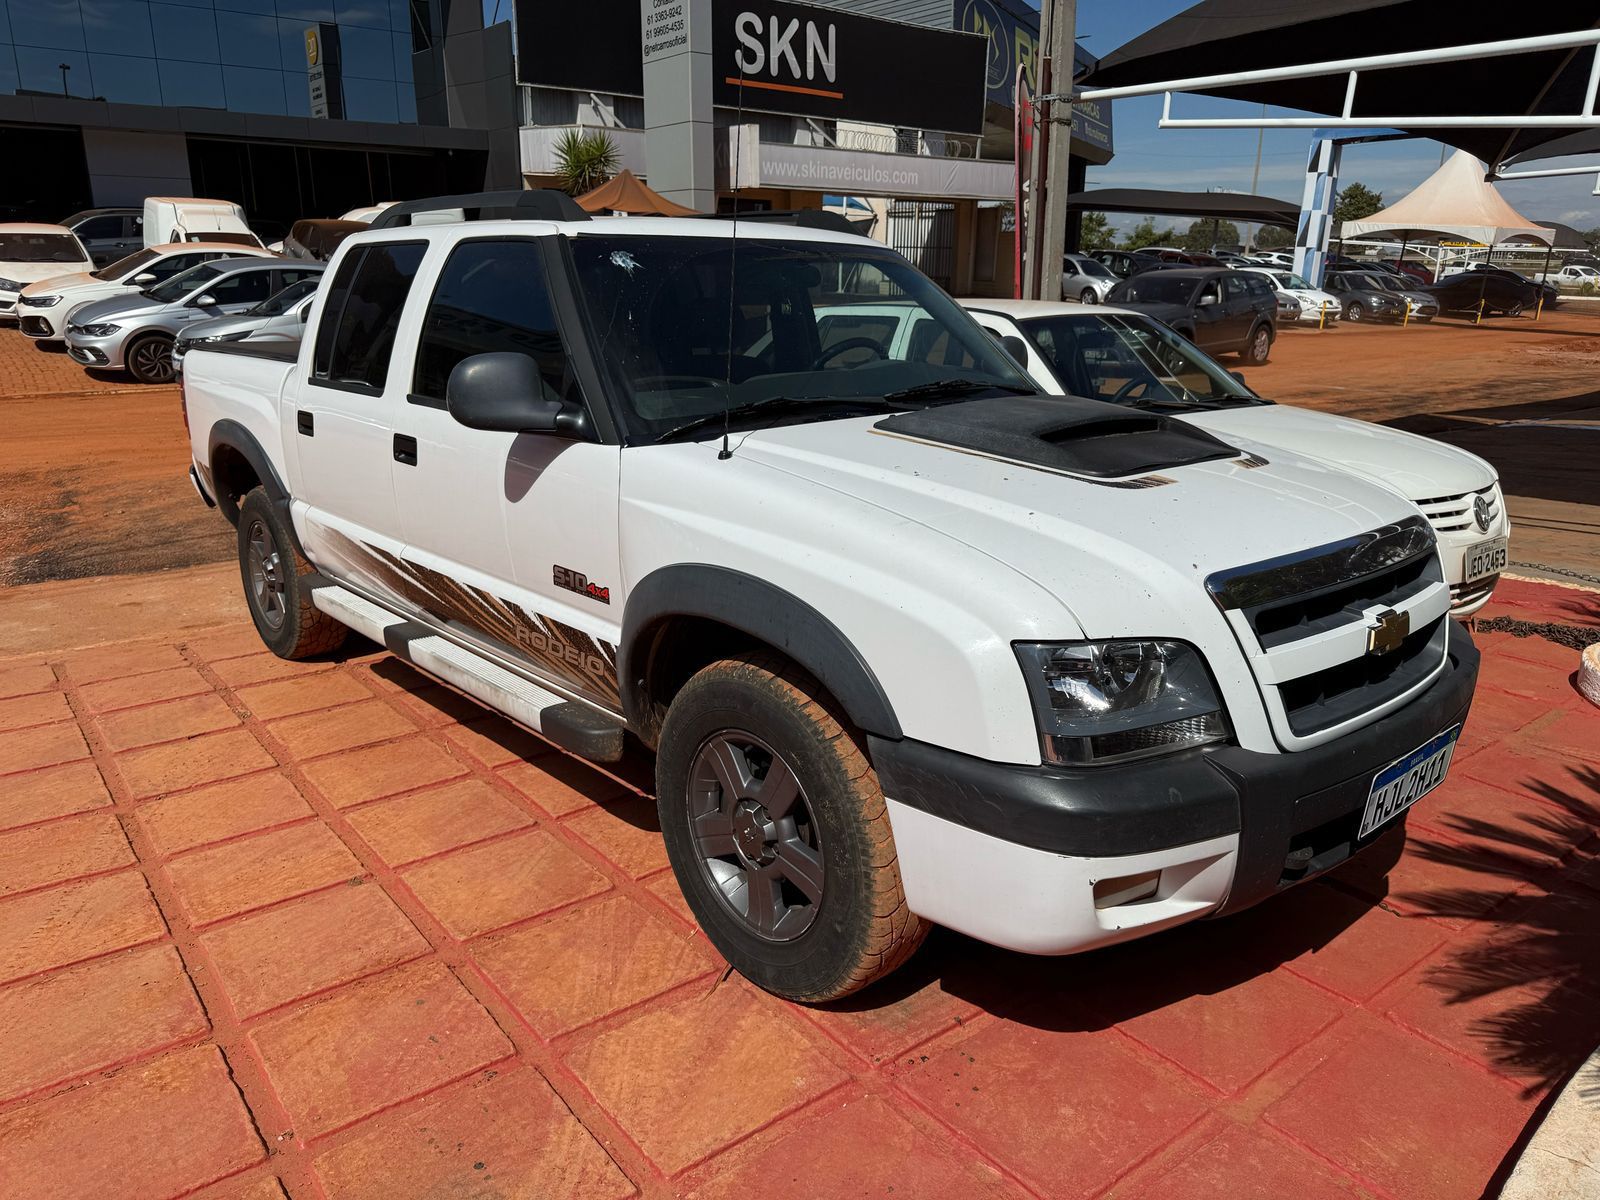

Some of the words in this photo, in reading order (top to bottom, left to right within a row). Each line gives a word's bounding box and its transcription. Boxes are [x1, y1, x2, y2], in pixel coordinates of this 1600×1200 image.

[647, 15, 654, 25] 61
[654, 5, 682, 22] 3363-9242
[646, 29, 652, 39] 61
[735, 12, 836, 83] SKN
[762, 160, 919, 185] www.skinaveiculos.com
[587, 583, 610, 600] 4x4
[516, 624, 605, 675] RODEIO
[1371, 748, 1447, 827] HJL2H11
